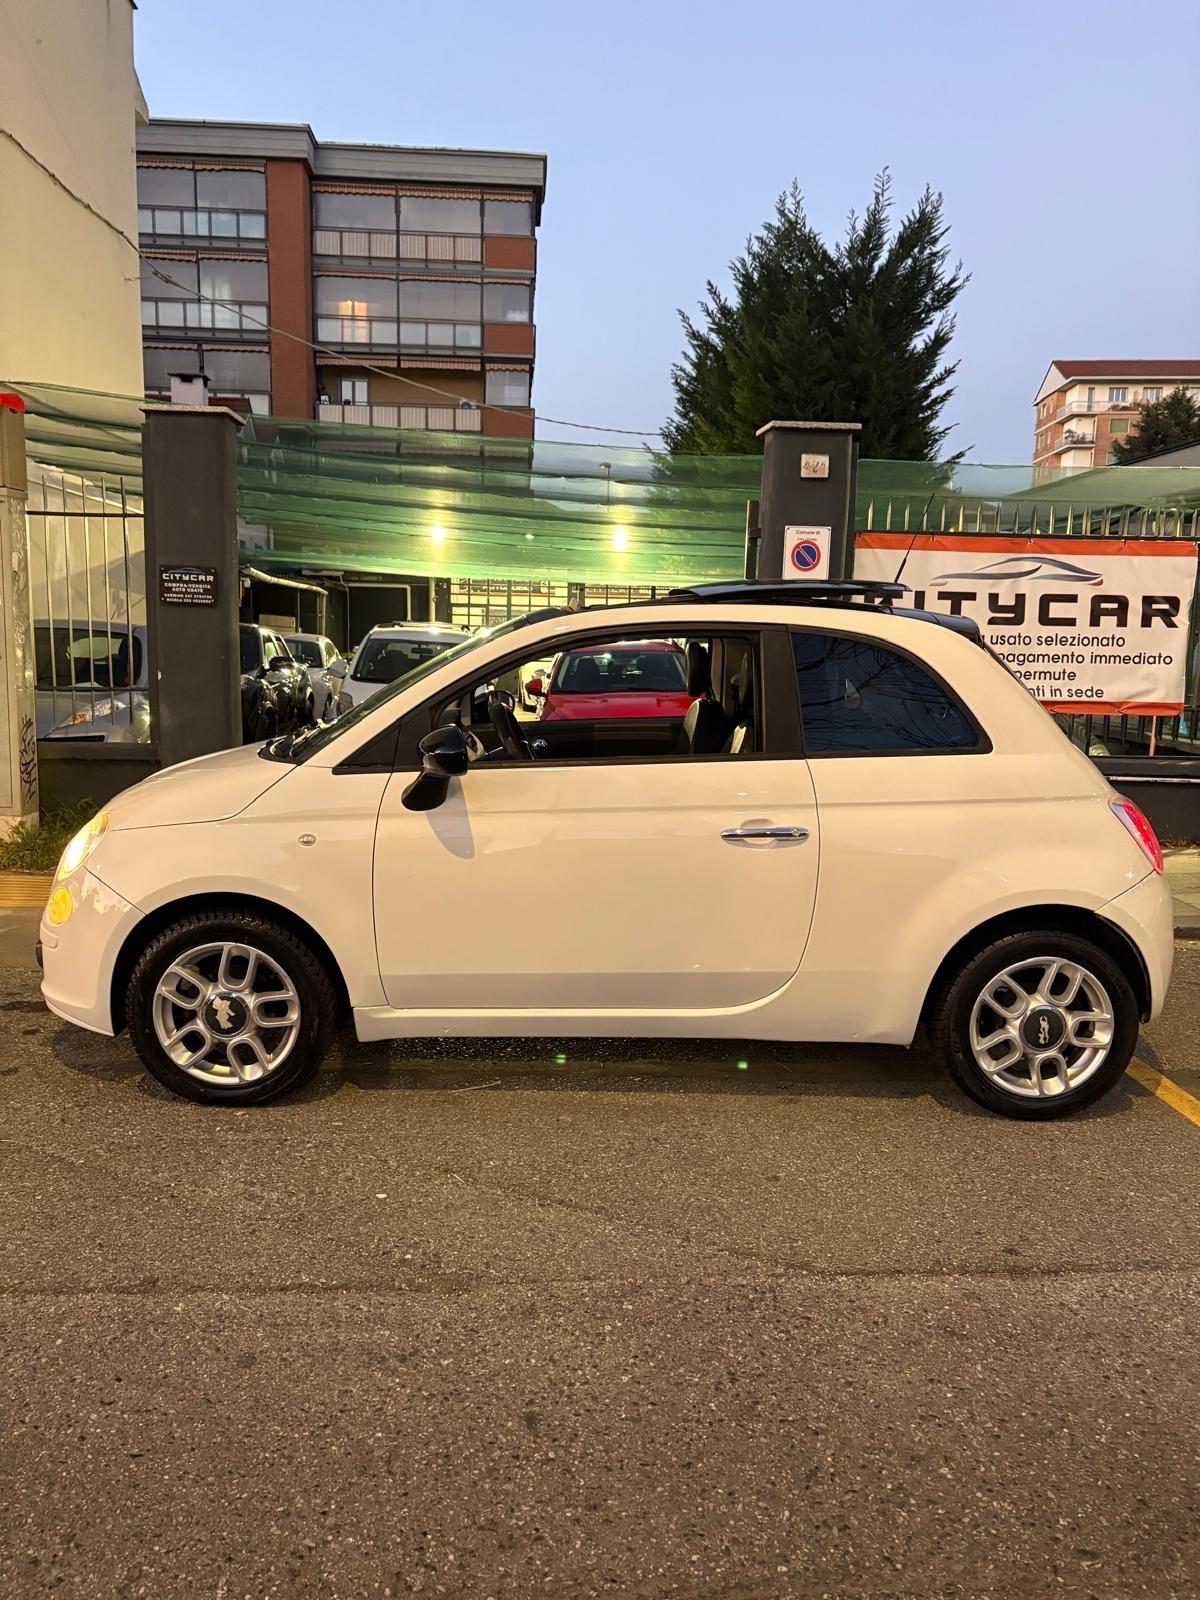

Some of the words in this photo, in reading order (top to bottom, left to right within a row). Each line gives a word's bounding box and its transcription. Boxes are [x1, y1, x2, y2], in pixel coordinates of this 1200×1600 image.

[163, 573, 214, 582] CITYCAR
[990, 633, 1032, 646] usato
[1036, 633, 1126, 647] selezionato
[1090, 652, 1173, 665] immediato
[1050, 685, 1062, 697] in
[1067, 686, 1104, 698] sede
